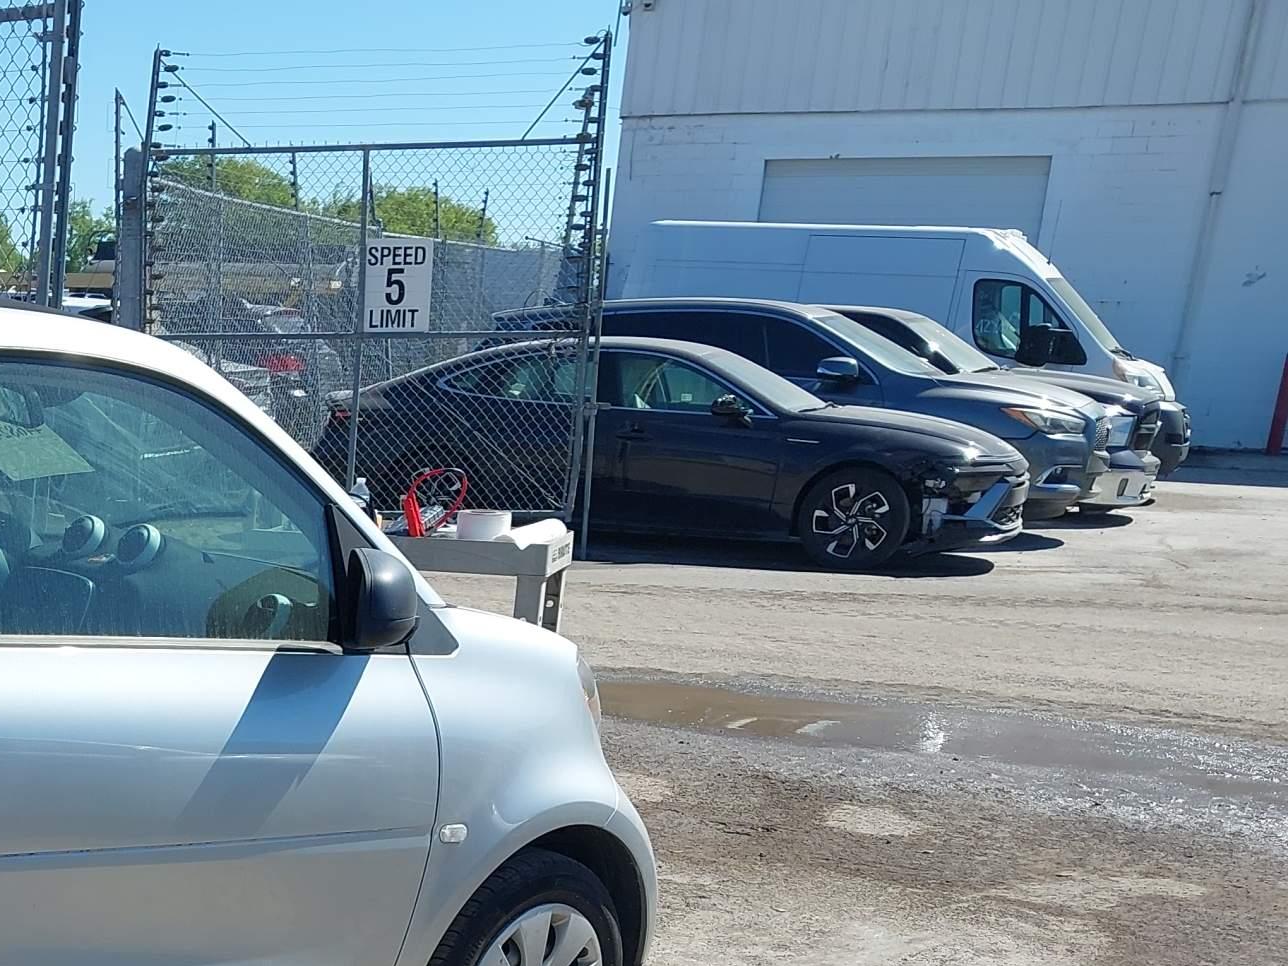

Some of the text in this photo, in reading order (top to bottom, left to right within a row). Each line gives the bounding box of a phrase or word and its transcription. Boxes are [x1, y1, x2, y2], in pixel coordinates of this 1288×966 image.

[368, 246, 426, 266] SPEED
[385, 268, 405, 305] 5
[369, 309, 419, 328] LIMIT
